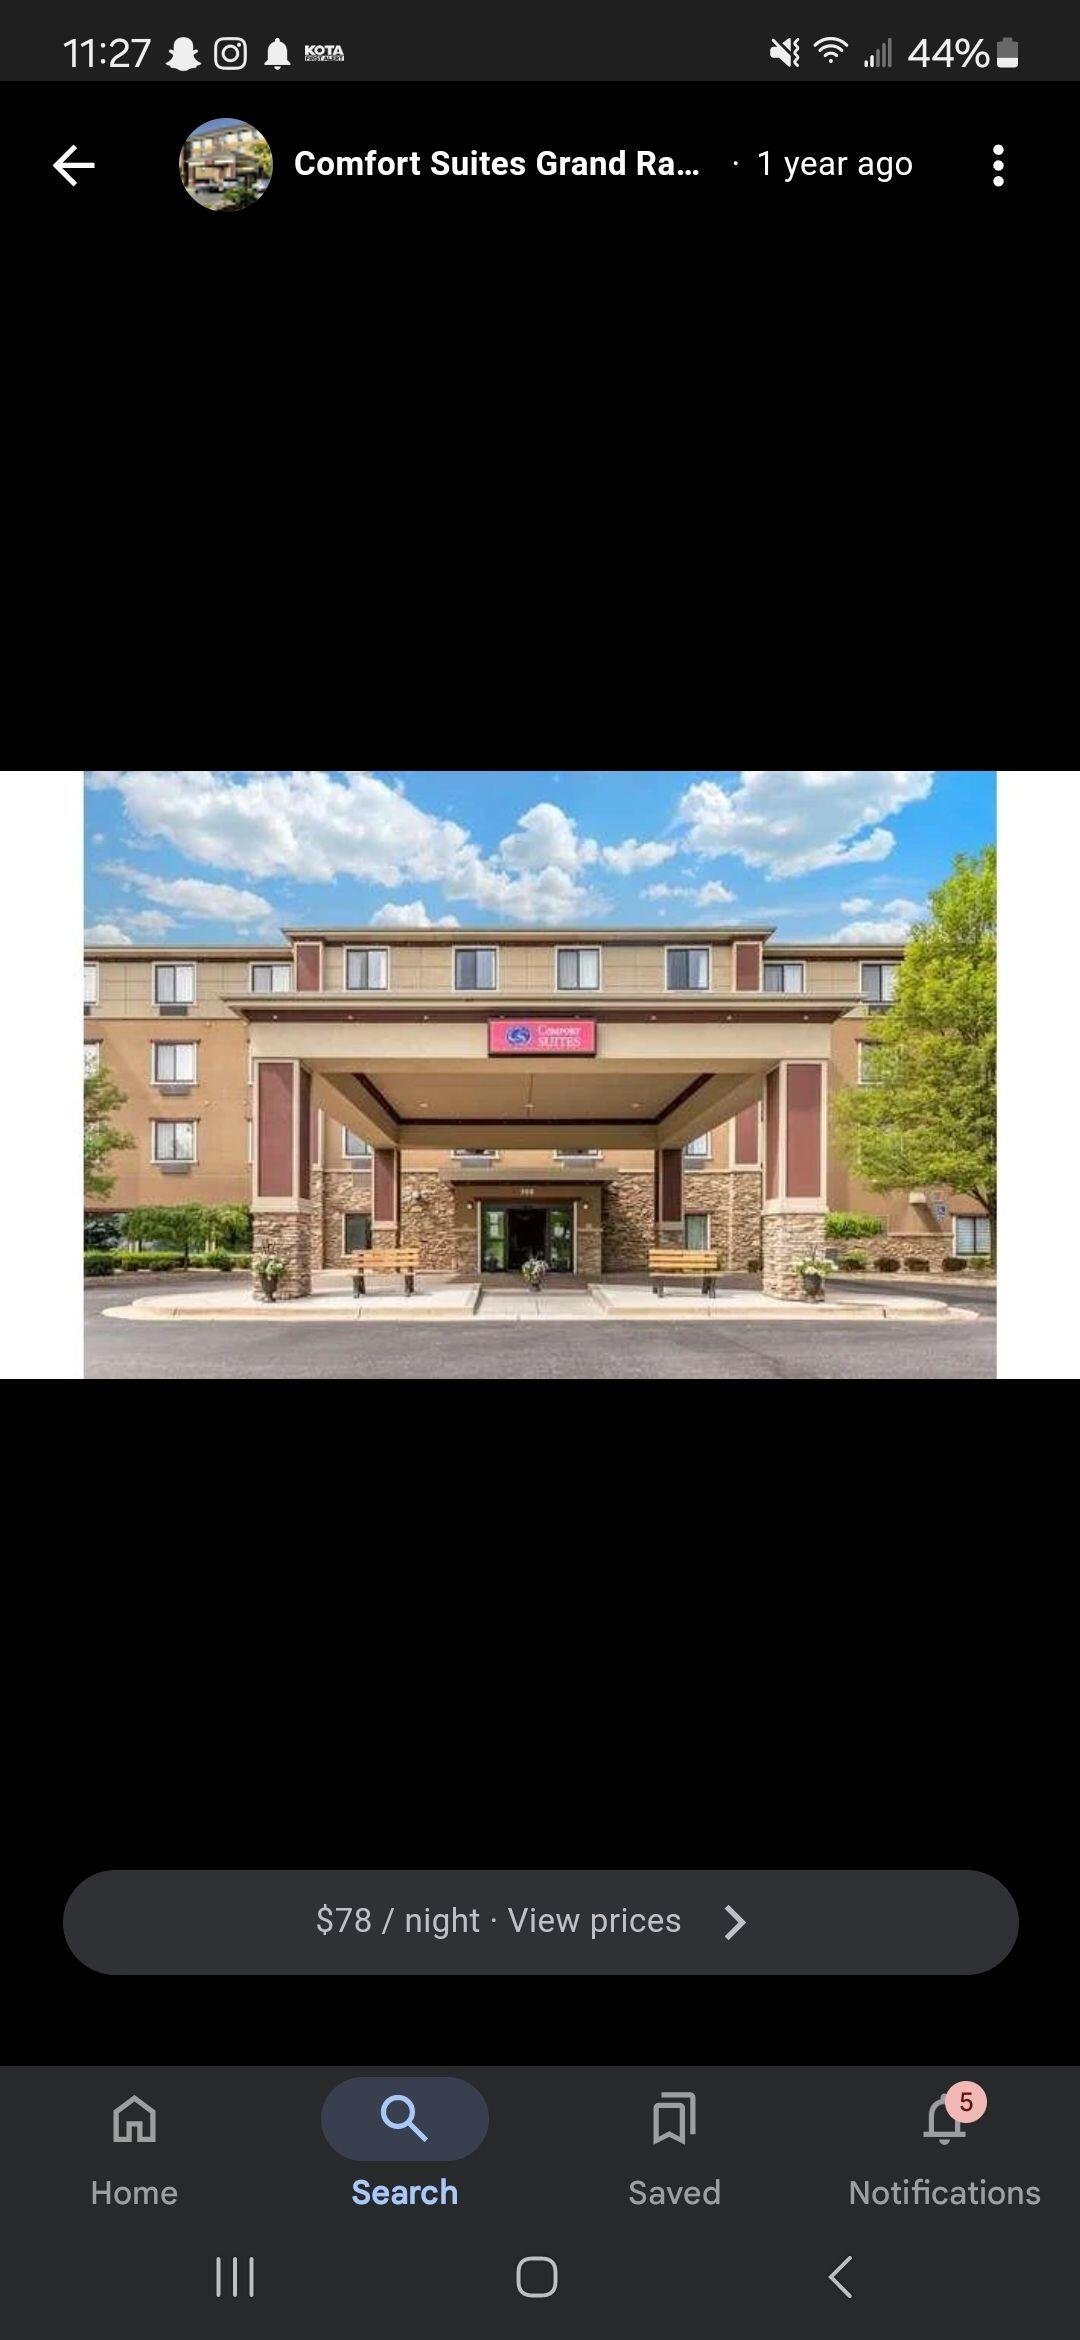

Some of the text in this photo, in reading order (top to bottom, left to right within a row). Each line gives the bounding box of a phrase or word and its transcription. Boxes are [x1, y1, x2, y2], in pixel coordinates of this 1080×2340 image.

[64, 38, 151, 68] 11:27
[305, 45, 344, 55] KOTA
[908, 37, 990, 68] 44%
[295, 149, 422, 176] Comfort
[431, 149, 526, 176] Suites
[537, 149, 626, 176] Grand
[758, 150, 769, 176] 1
[784, 153, 848, 183] year
[858, 156, 913, 183] ago
[538, 1037, 581, 1047] SUITES
[316, 1903, 372, 1936] $78
[405, 1906, 480, 1940] night
[508, 1907, 581, 1933] View
[592, 1907, 681, 1940] prices
[960, 2091, 974, 2113] 5
[92, 2180, 178, 2206] Home
[352, 2177, 458, 2206] Search
[629, 2178, 721, 2206] Saved
[850, 2178, 1041, 2206] Notifications
